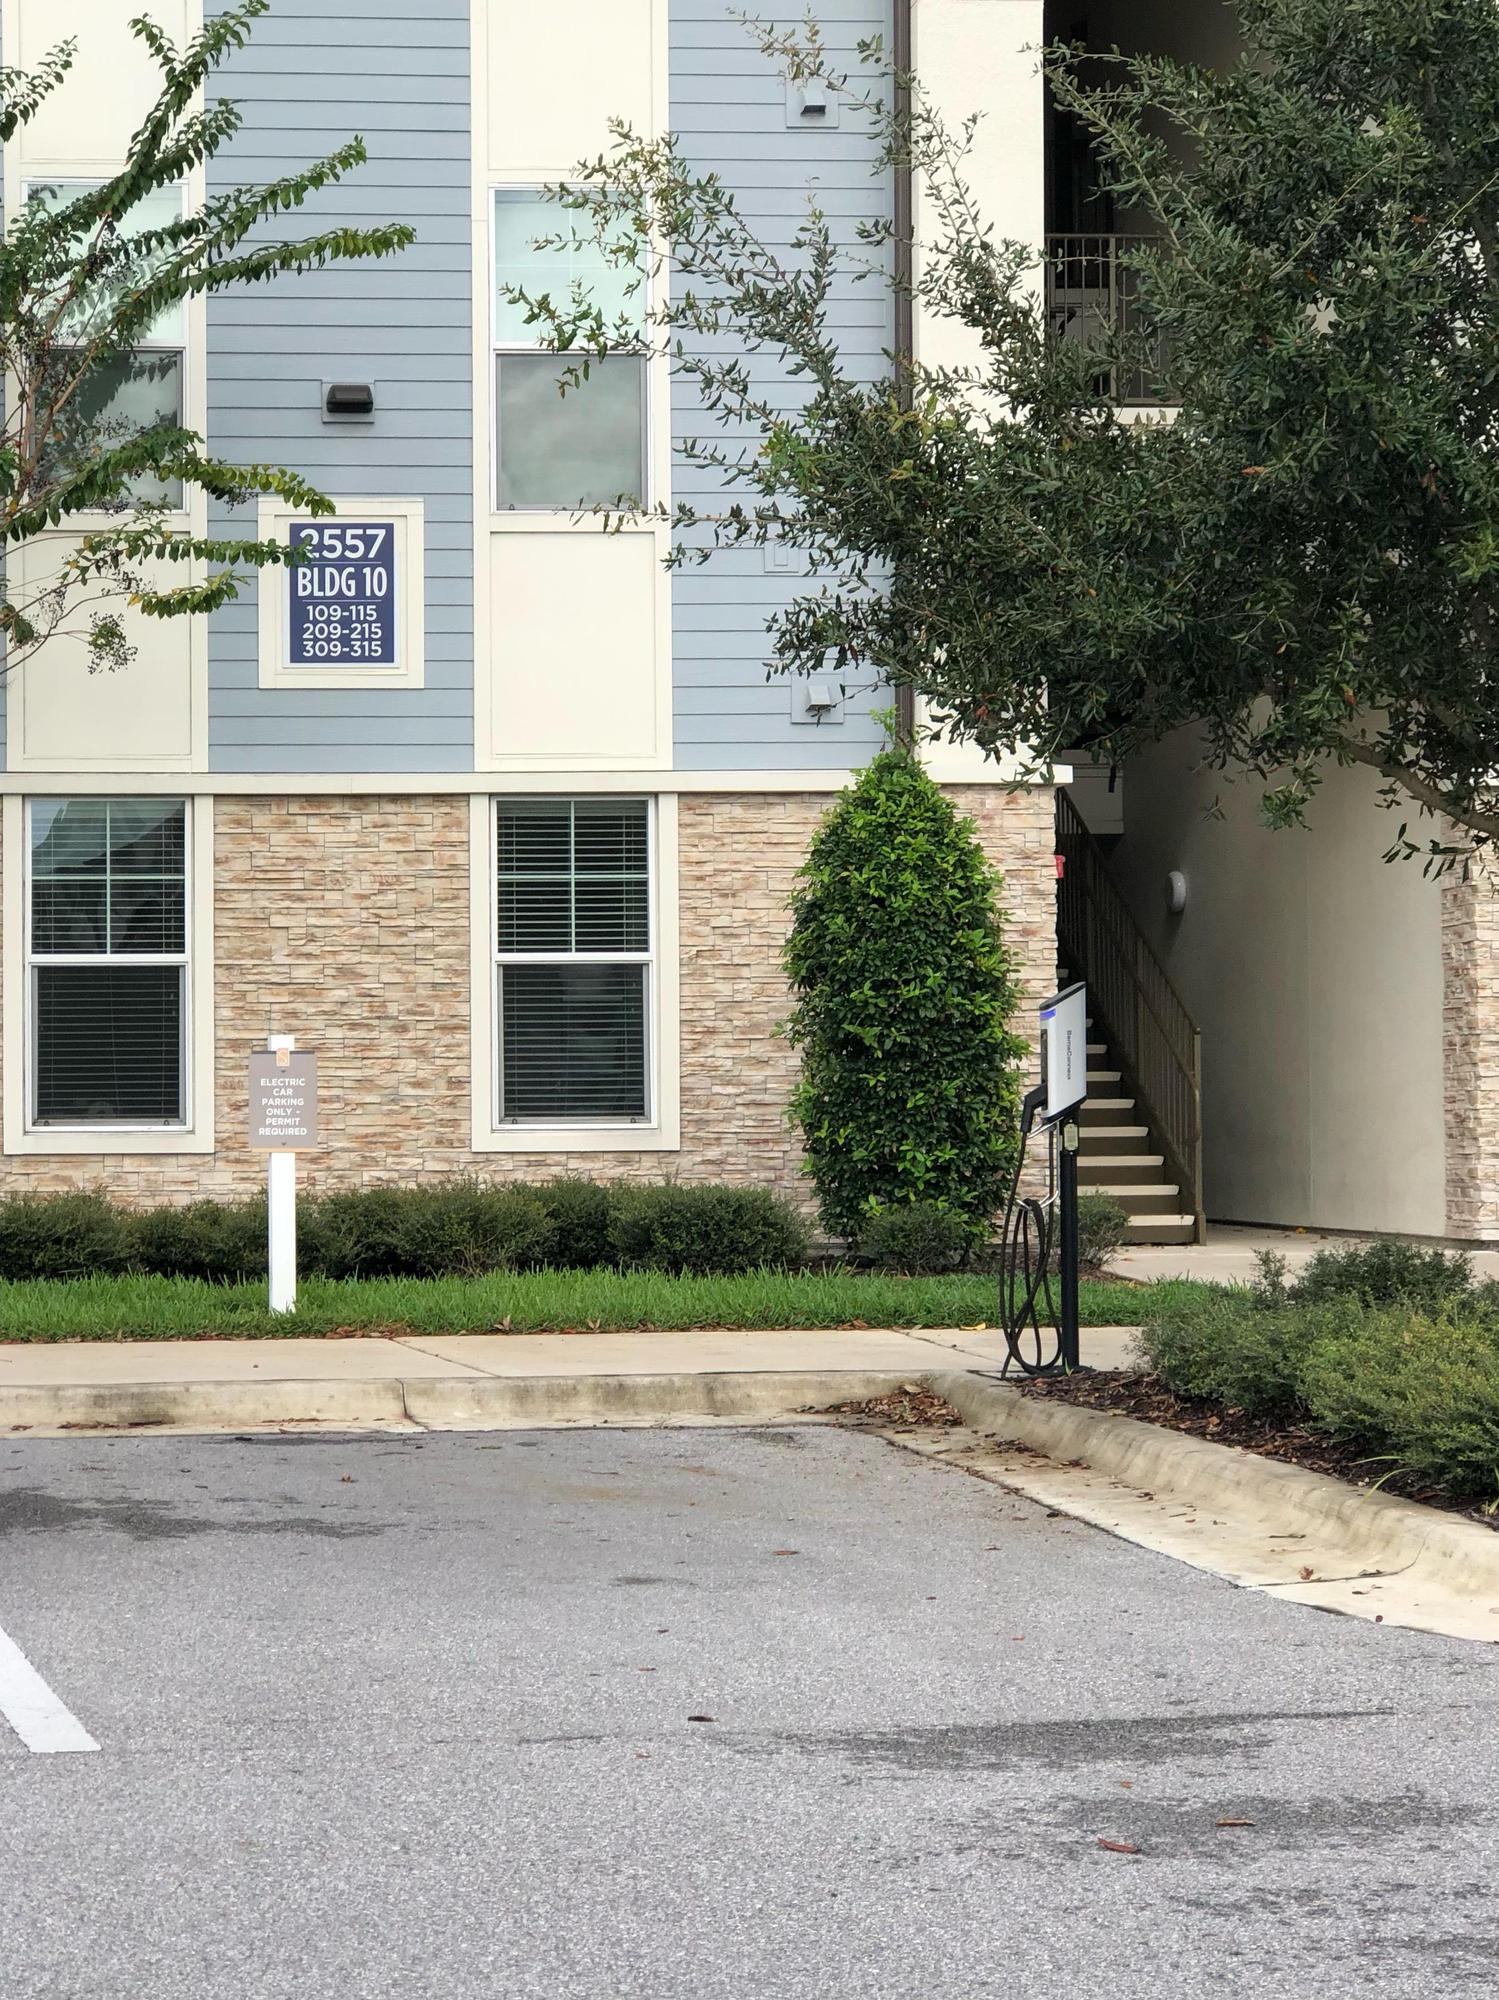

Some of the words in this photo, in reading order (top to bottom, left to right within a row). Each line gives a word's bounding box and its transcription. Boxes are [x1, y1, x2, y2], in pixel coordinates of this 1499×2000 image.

[299, 528, 387, 559] 2557
[297, 567, 356, 597] BLDG
[362, 567, 388, 597] 10
[306, 605, 377, 621] 109-115
[302, 623, 382, 639] 209-215
[302, 641, 382, 657] 309-315
[260, 1078, 306, 1087] ELECTRIC
[272, 1088, 294, 1096] CAR
[261, 1098, 304, 1106] PARKING
[266, 1108, 292, 1116] ONLY
[265, 1117, 301, 1126] PERMIT
[258, 1127, 308, 1136] REQUIRED
